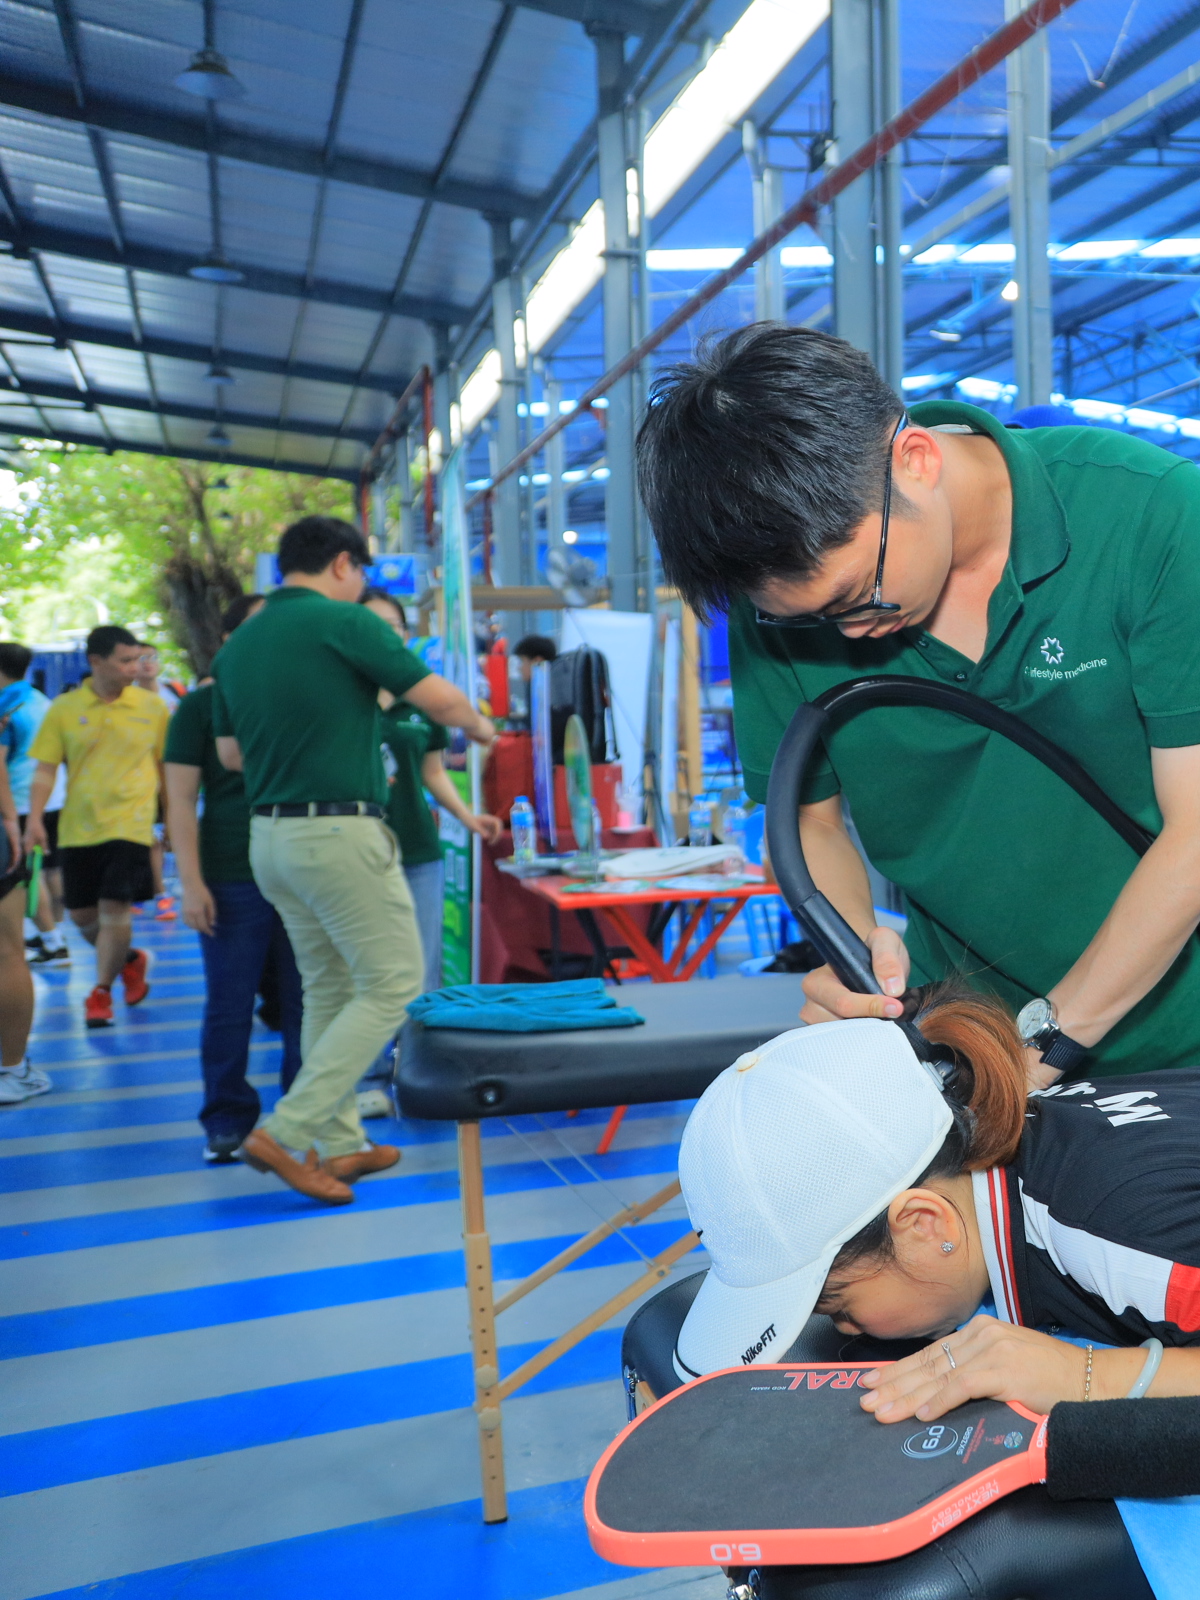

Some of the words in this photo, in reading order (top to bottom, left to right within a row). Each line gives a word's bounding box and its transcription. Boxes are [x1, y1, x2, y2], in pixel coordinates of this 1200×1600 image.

[922, 1425, 946, 1450] 6.0
[931, 1479, 999, 1524] TECHNOLOGY
[965, 1485, 1000, 1513] NEXT
[709, 1543, 762, 1561] 6.0
